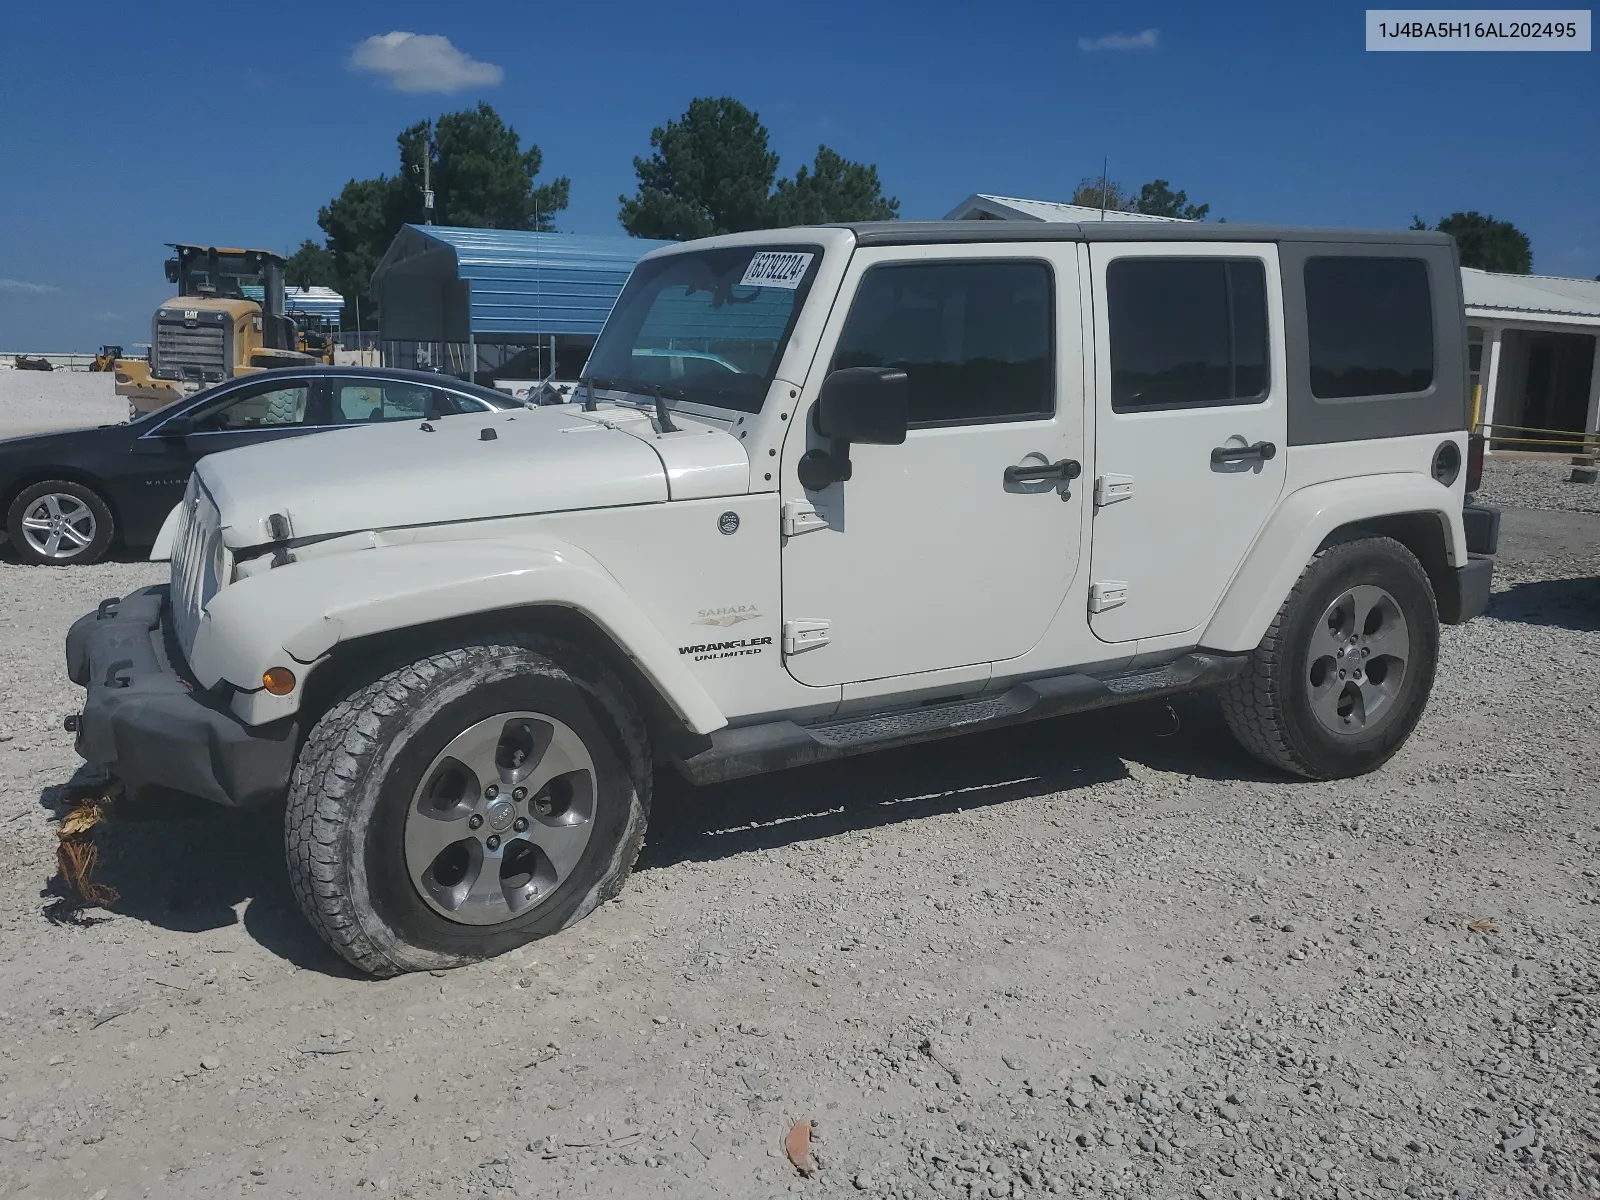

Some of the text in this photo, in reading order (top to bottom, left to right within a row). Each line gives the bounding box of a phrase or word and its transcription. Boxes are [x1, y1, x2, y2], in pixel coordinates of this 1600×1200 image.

[751, 254, 804, 280] 63792224
[184, 310, 199, 319] CAT
[698, 604, 757, 618] SAHARA
[678, 636, 773, 655] WRANGLER
[694, 648, 762, 662] UNLIMITED
